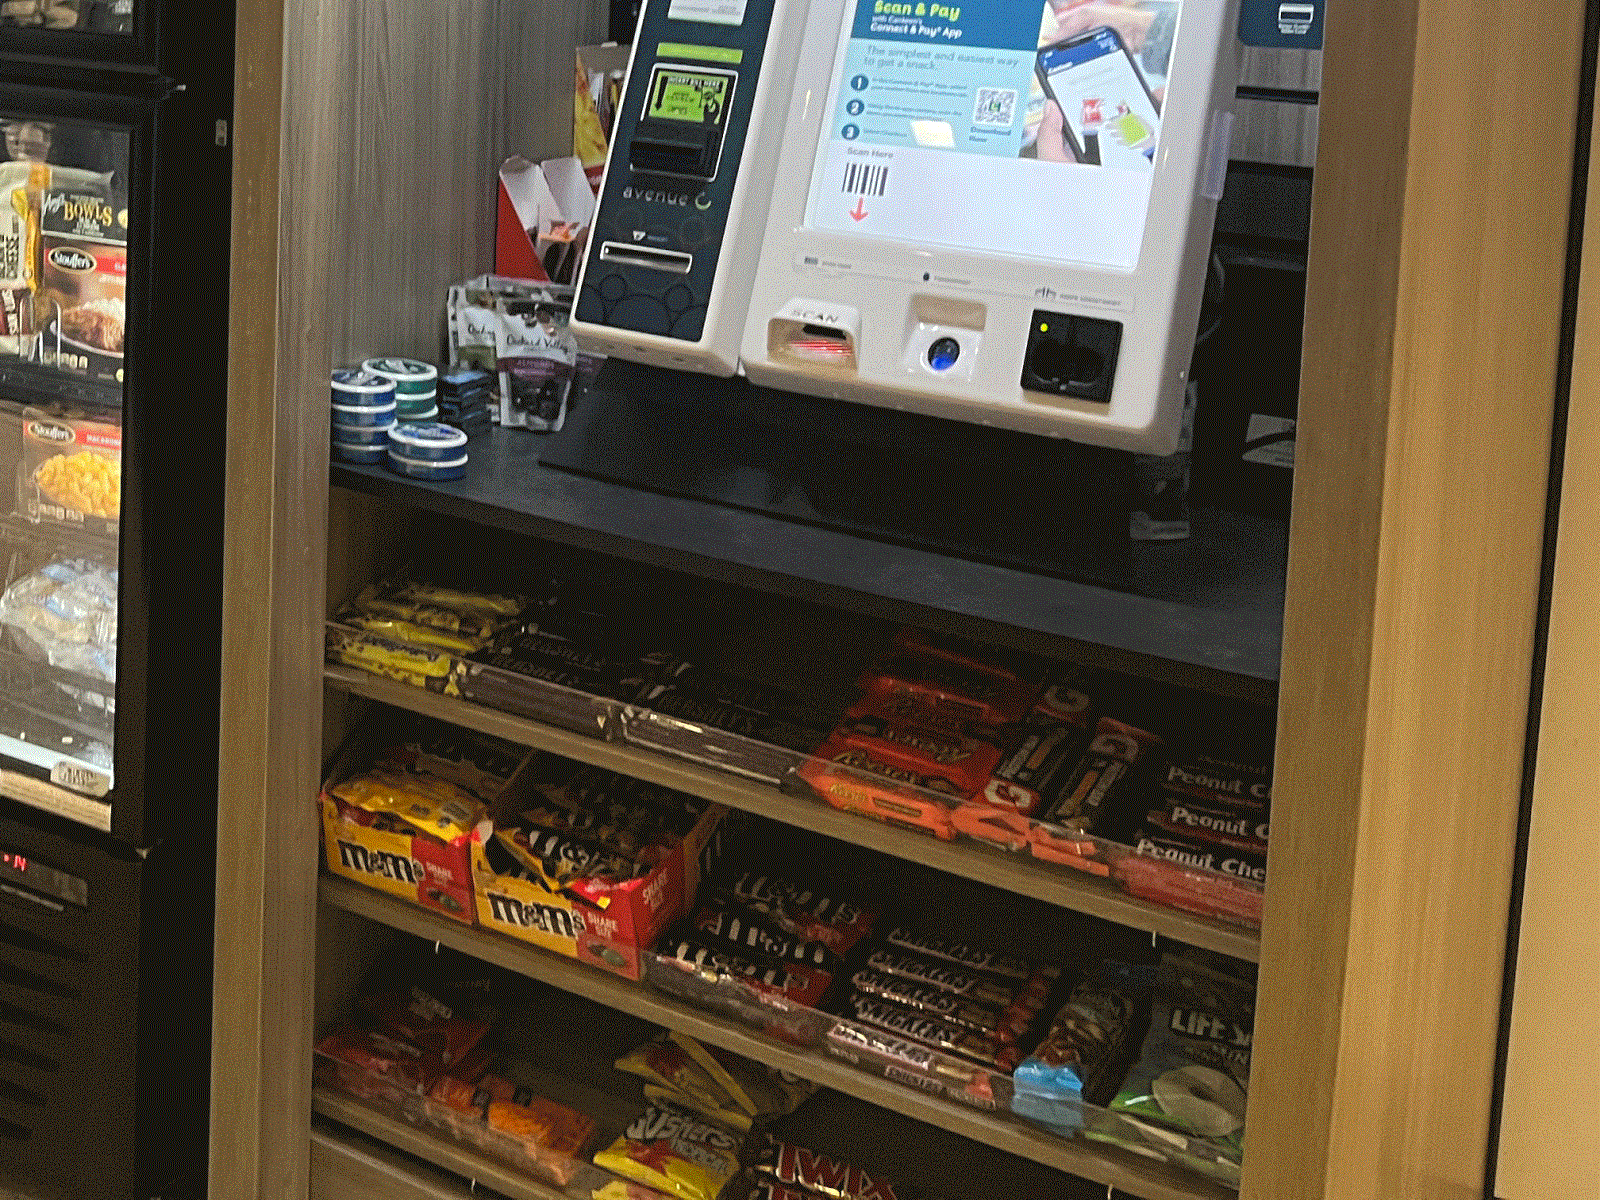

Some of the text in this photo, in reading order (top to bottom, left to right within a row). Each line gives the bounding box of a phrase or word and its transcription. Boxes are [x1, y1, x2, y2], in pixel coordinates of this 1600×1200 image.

[873, 0, 961, 22] Scan & Pay
[870, 22, 909, 34] Connect
[942, 27, 963, 39] App
[864, 56, 875, 66] to
[877, 58, 896, 70] get
[897, 60, 904, 68] a
[866, 45, 1019, 68] The simplest and easiest way
[847, 147, 894, 159] Scan Here
[622, 185, 689, 207] avenue
[63, 200, 114, 227] BOWLS
[792, 307, 840, 325] SCAN
[505, 332, 570, 355] Orchard Valley
[1166, 763, 1243, 795] Peanut
[1170, 807, 1246, 839] Peanut
[1136, 838, 1215, 870] Peanut
